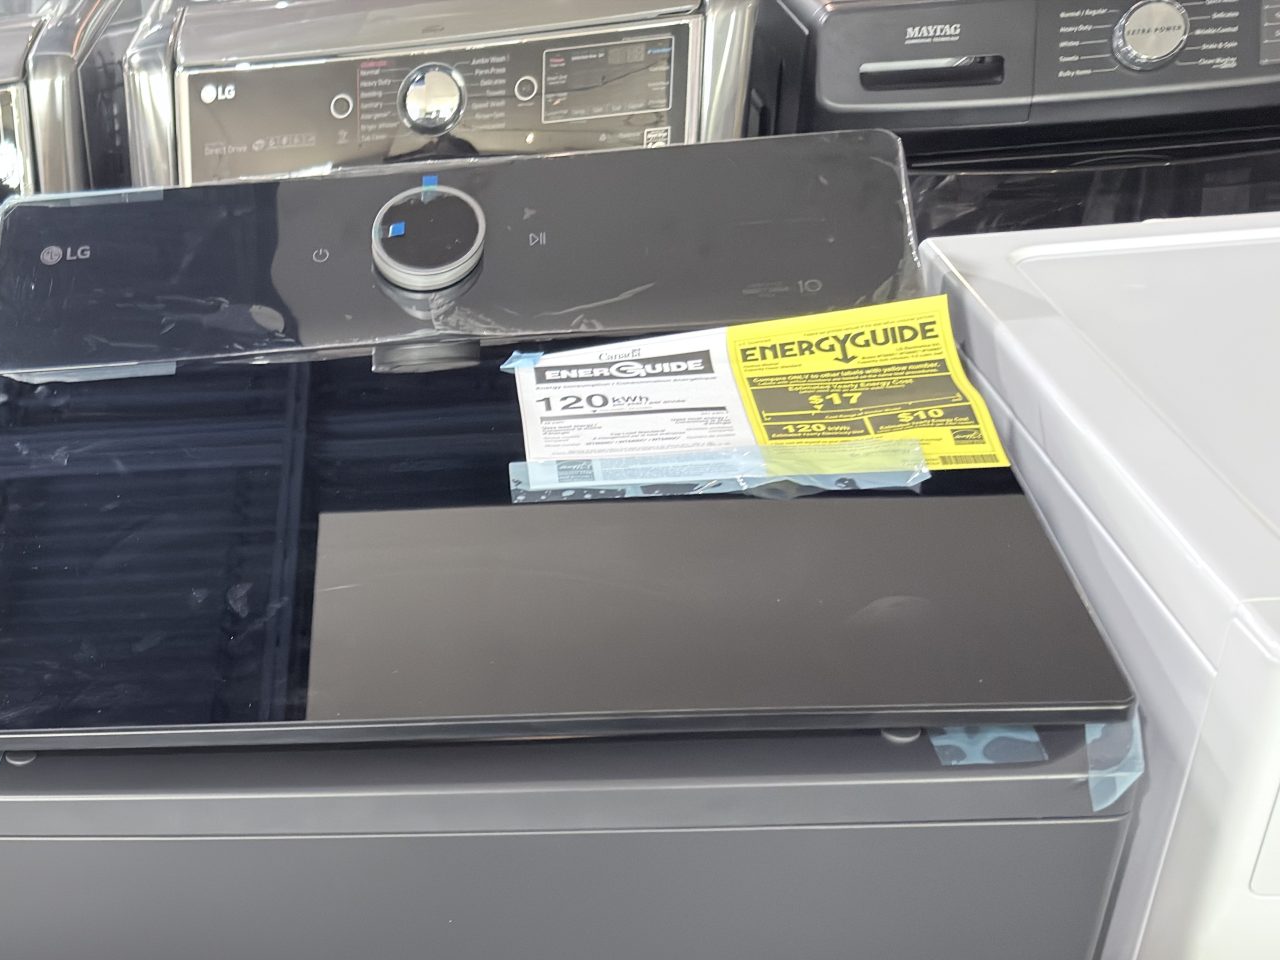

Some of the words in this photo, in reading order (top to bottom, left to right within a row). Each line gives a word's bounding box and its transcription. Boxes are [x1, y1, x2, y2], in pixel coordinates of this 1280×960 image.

[905, 23, 961, 39] MAYTAG
[740, 320, 940, 363] ENERGYGUIDE
[545, 359, 705, 380] ENERGUIDE
[536, 393, 609, 411] 120
[612, 395, 648, 403] kWh
[808, 392, 863, 406] $17
[897, 408, 944, 422] $10
[782, 423, 826, 433] 120
